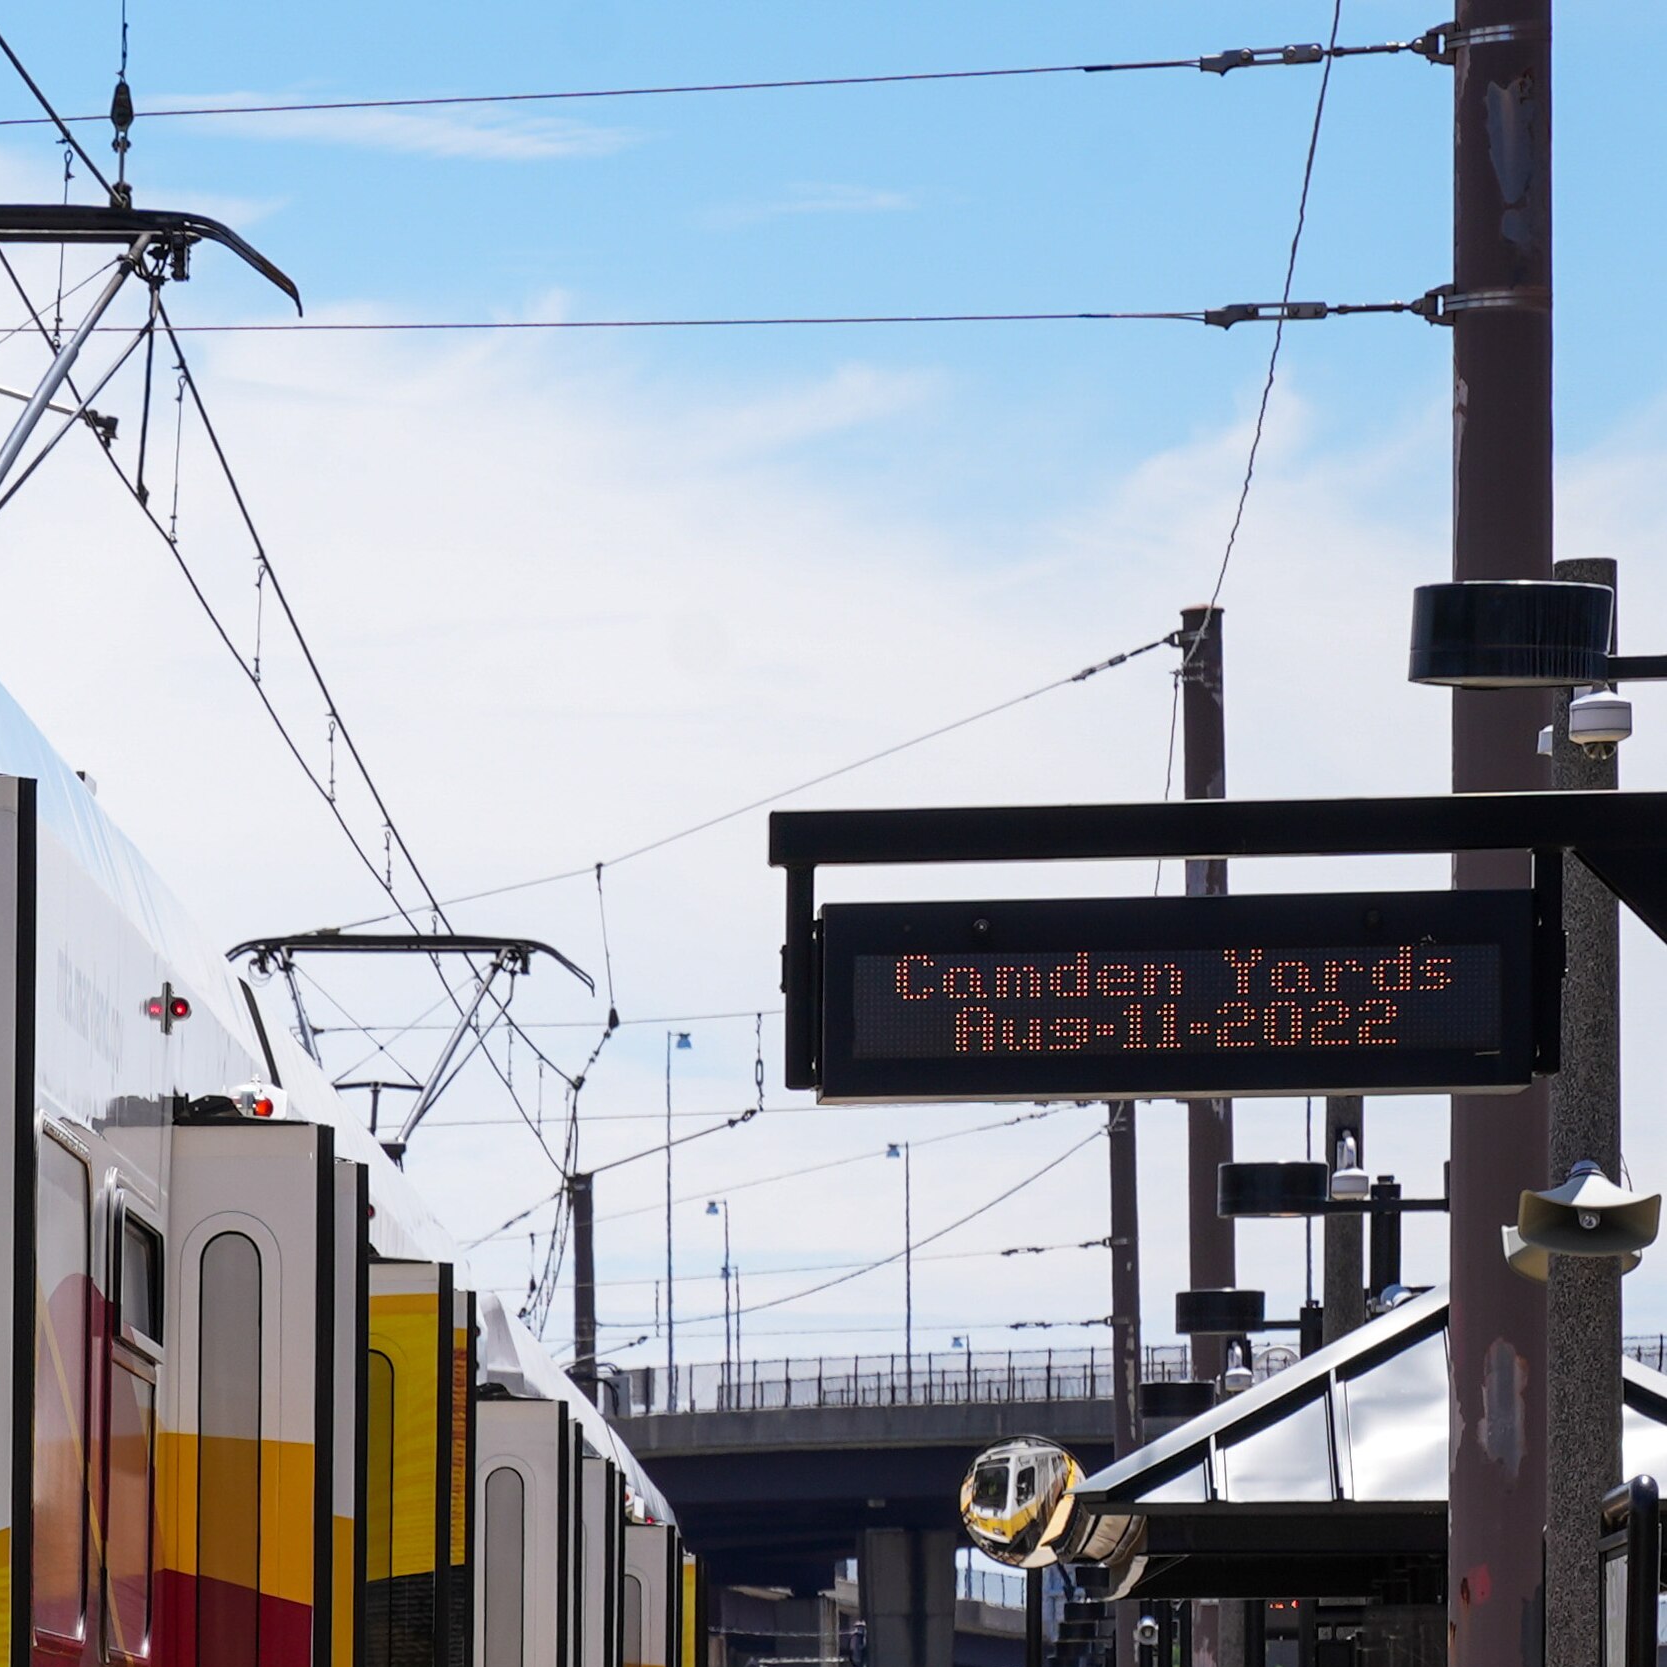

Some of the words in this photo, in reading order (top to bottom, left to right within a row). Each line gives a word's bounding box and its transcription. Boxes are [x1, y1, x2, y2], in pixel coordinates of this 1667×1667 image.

[894, 951, 1183, 1001] Camden
[1222, 945, 1454, 997] Yards
[953, 998, 1399, 1053] Aug-11-2022
